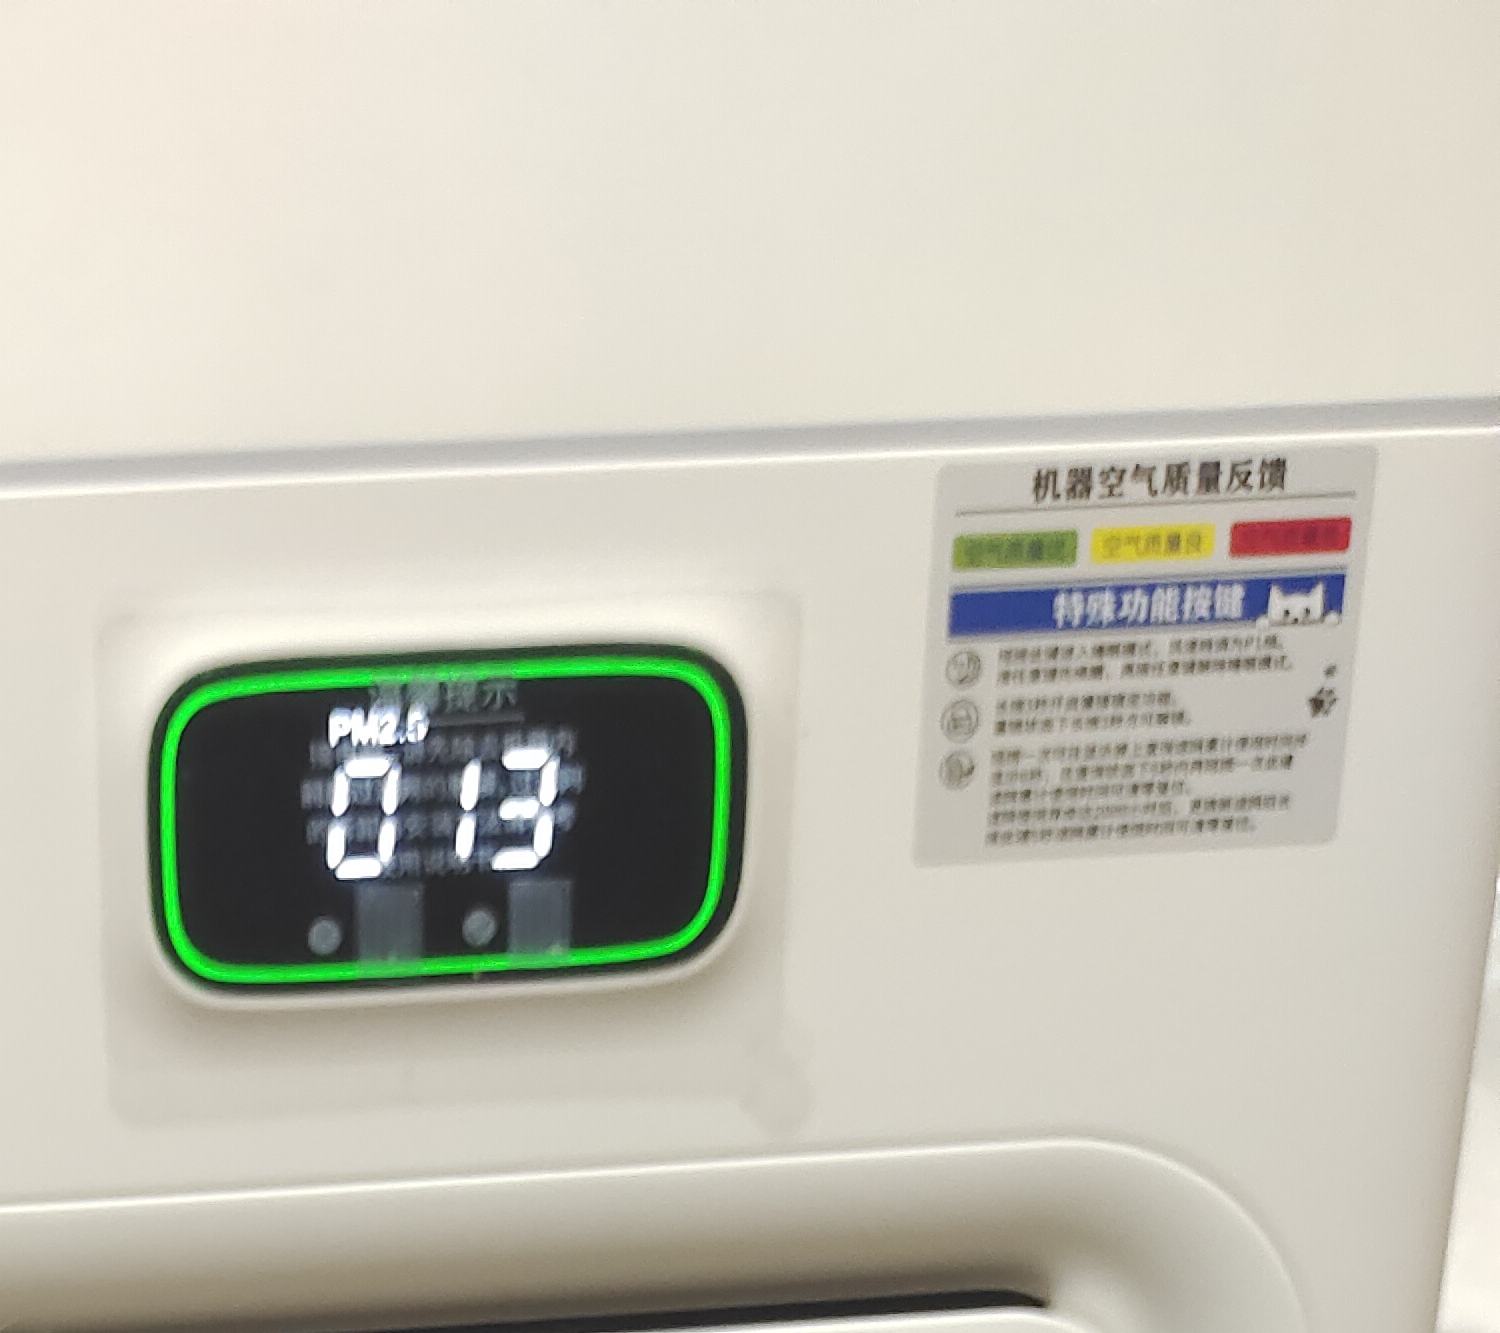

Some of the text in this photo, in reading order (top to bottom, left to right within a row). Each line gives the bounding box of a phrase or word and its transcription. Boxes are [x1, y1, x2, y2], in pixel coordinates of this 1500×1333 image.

[1032, 457, 1288, 502] 机器空气质量反馈
[1052, 582, 1246, 629] 特殊功能按键
[326, 746, 561, 880] 013
